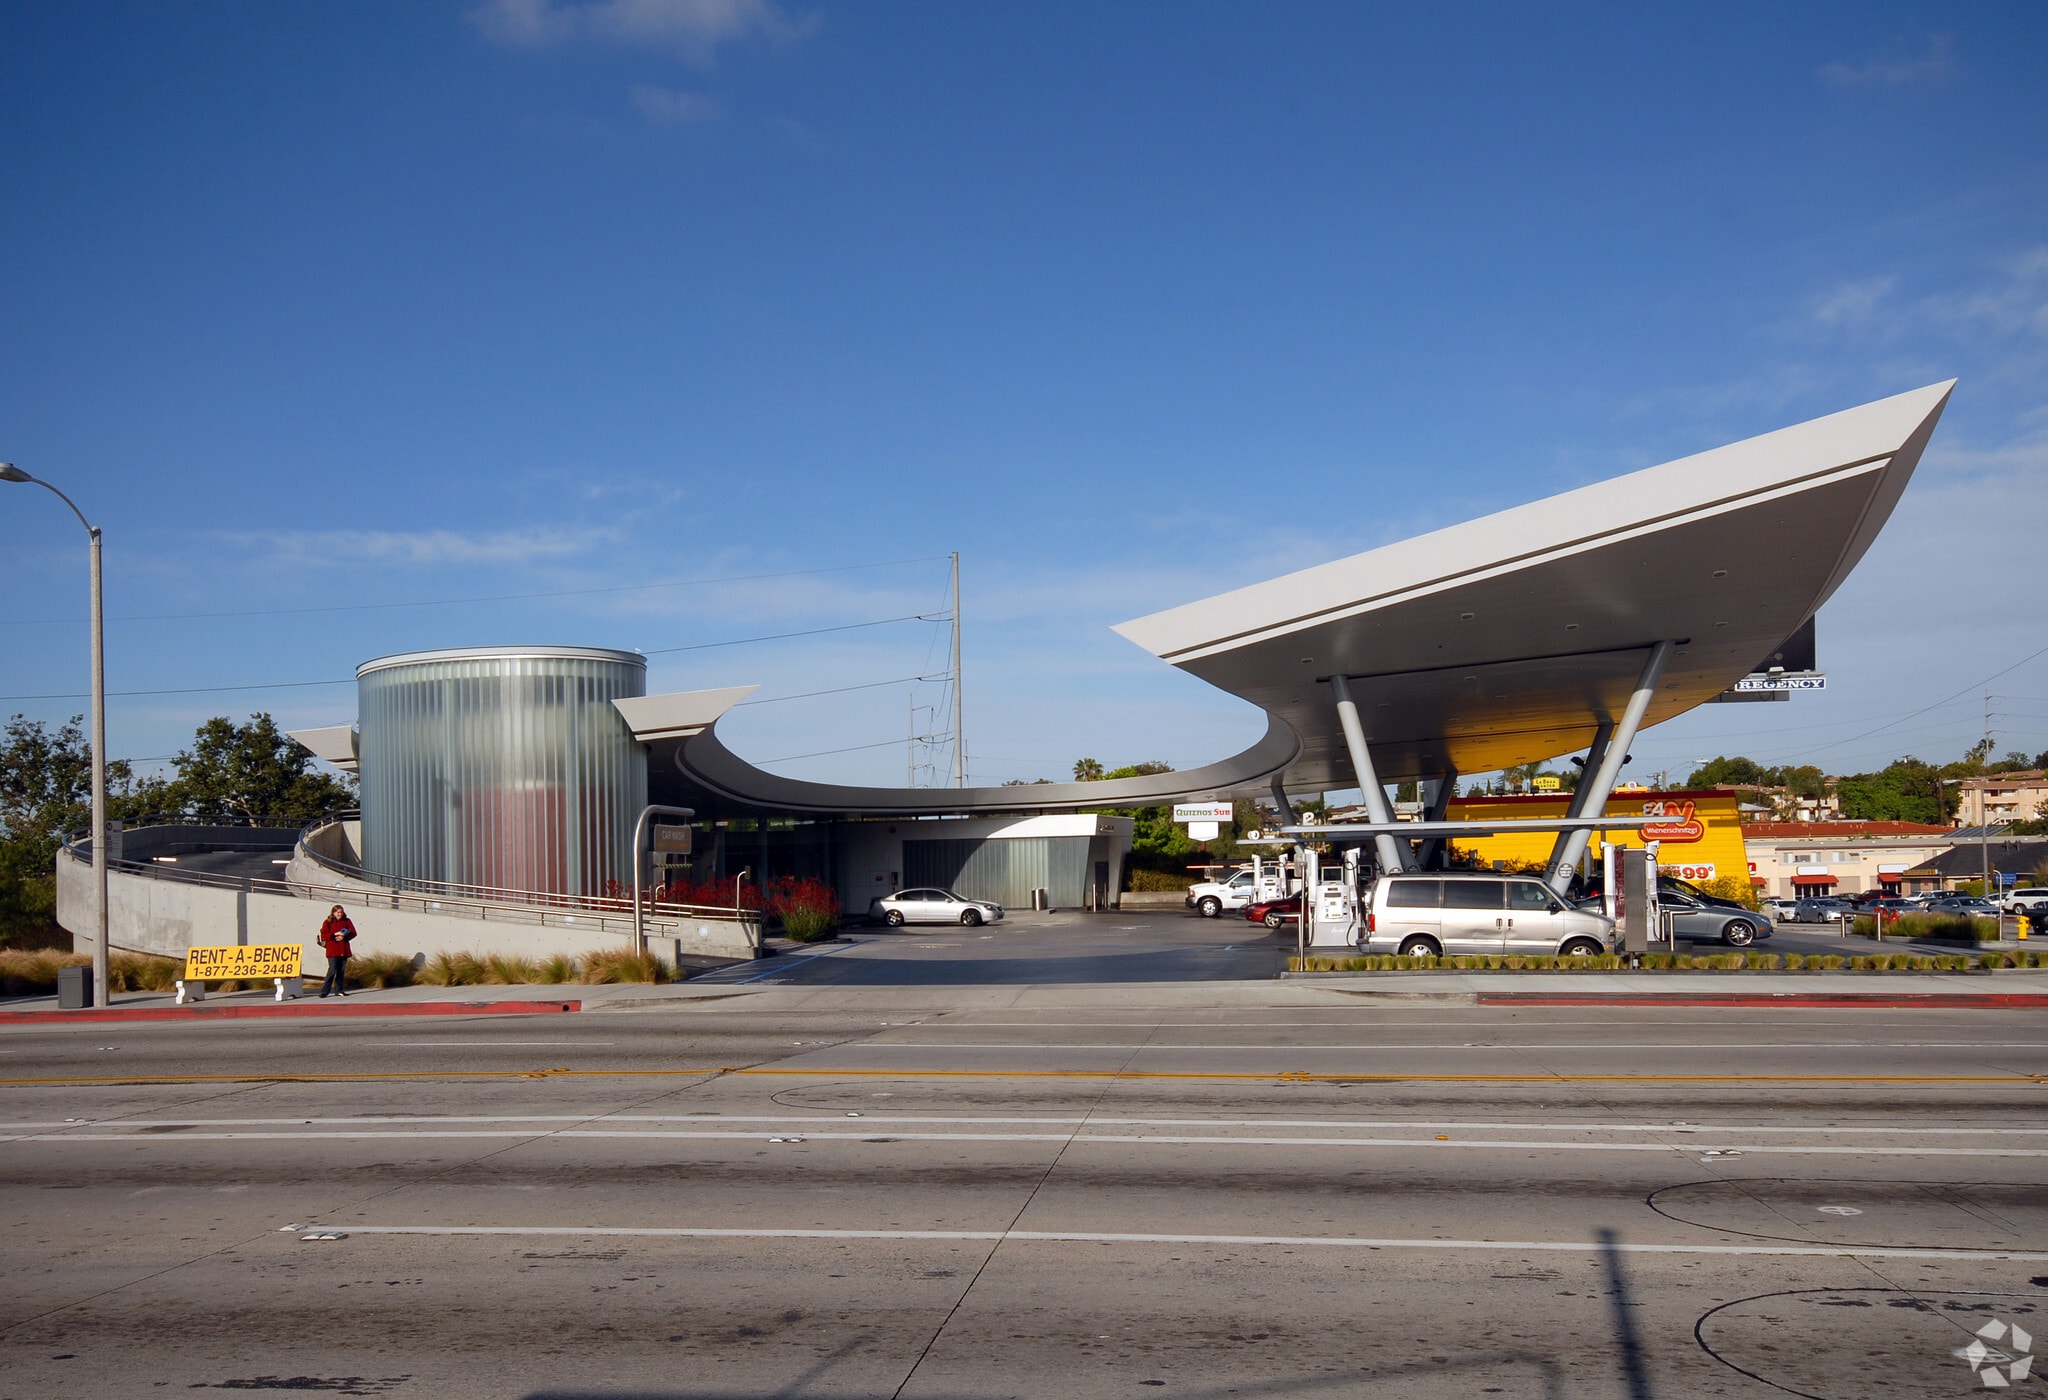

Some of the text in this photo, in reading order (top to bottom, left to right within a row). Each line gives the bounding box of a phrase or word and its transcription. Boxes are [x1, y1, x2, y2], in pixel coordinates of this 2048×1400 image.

[1739, 679, 1822, 689] REGENCY
[662, 831, 671, 840] CAR
[193, 963, 294, 977] 1-877-236-2448
